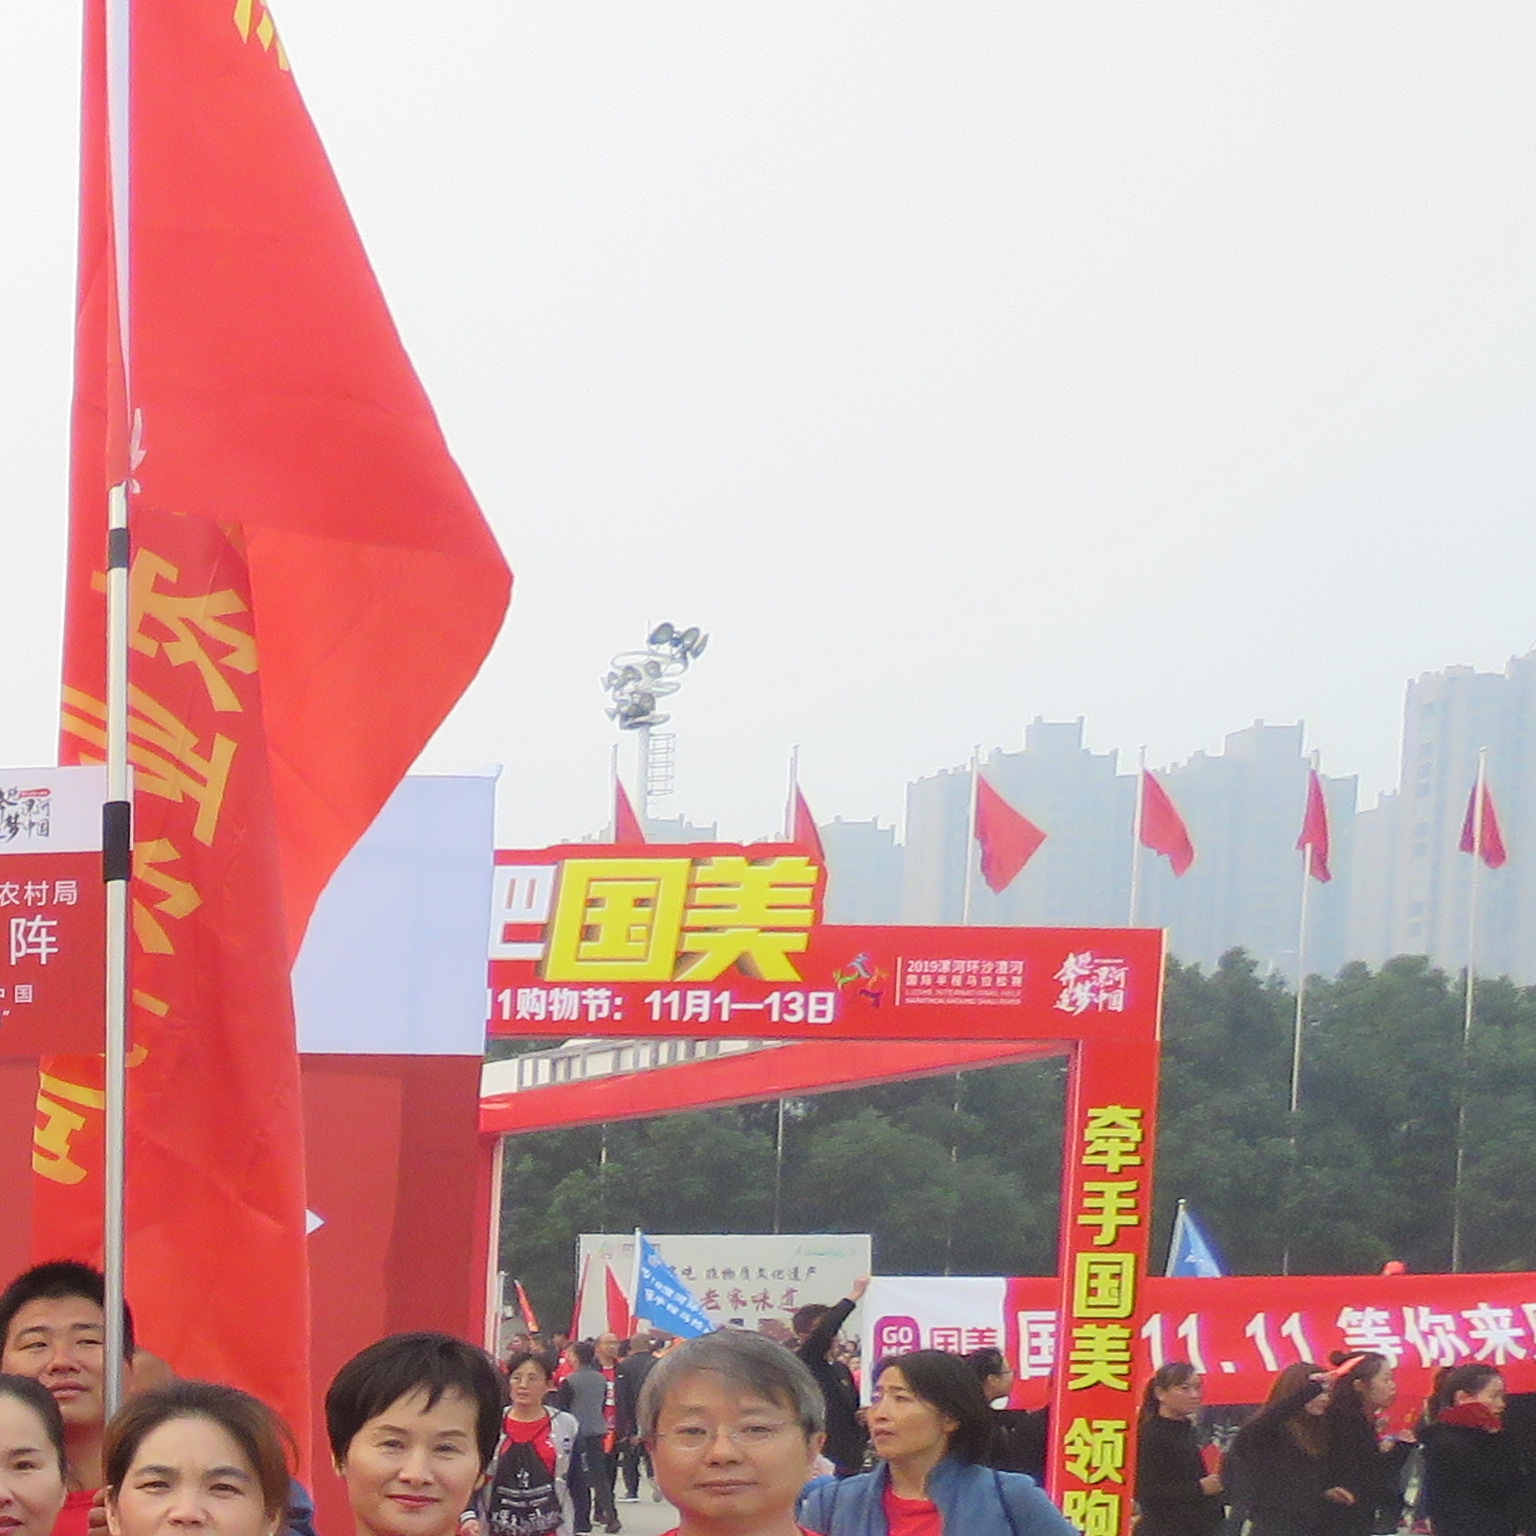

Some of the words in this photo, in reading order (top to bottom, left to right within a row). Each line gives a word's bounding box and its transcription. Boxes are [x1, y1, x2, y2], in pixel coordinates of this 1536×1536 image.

[1068, 1104, 1143, 1392] 牵手国美
[1334, 1302, 1536, 1370] 等你来
